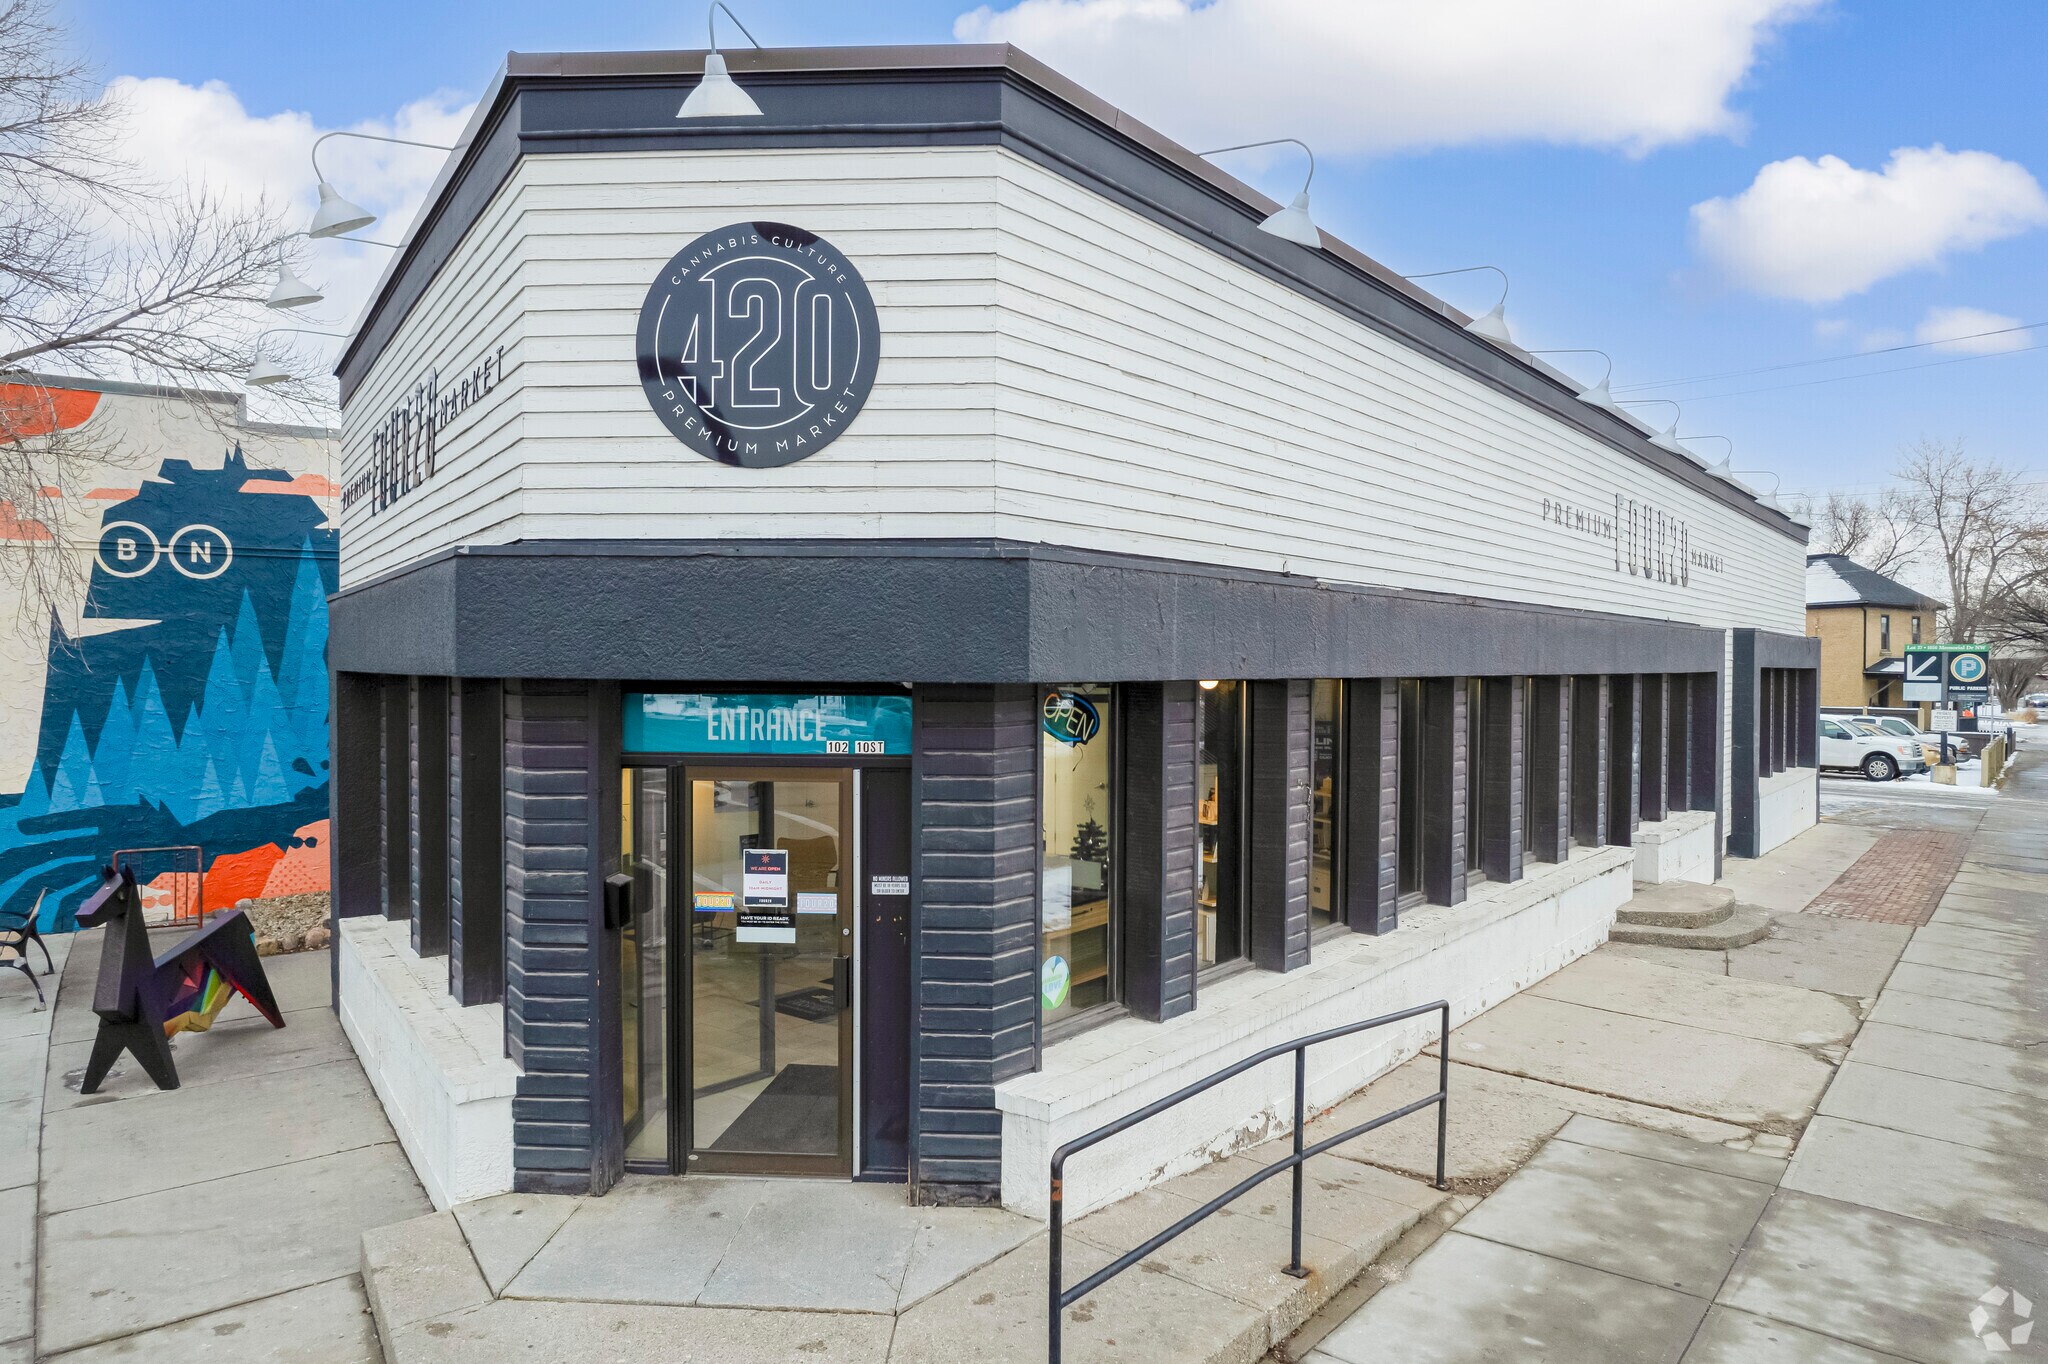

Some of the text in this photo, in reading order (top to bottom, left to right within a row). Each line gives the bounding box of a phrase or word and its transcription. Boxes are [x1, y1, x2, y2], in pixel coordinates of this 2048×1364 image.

[672, 235, 846, 285] CANNABIS CULTURE
[677, 277, 832, 408] 420
[343, 468, 372, 510] PREMIUM
[440, 345, 504, 428] MARKET
[662, 388, 855, 454] PREMIUM MARKET
[1543, 497, 1611, 539] PREMIUM
[1691, 548, 1724, 574] MARKET
[1961, 660, 1976, 676] P
[707, 708, 827, 741] ENTRANCE
[1044, 693, 1094, 741] OPEN
[828, 742, 883, 753] 102 10ST
[697, 896, 731, 908] FOUR20
